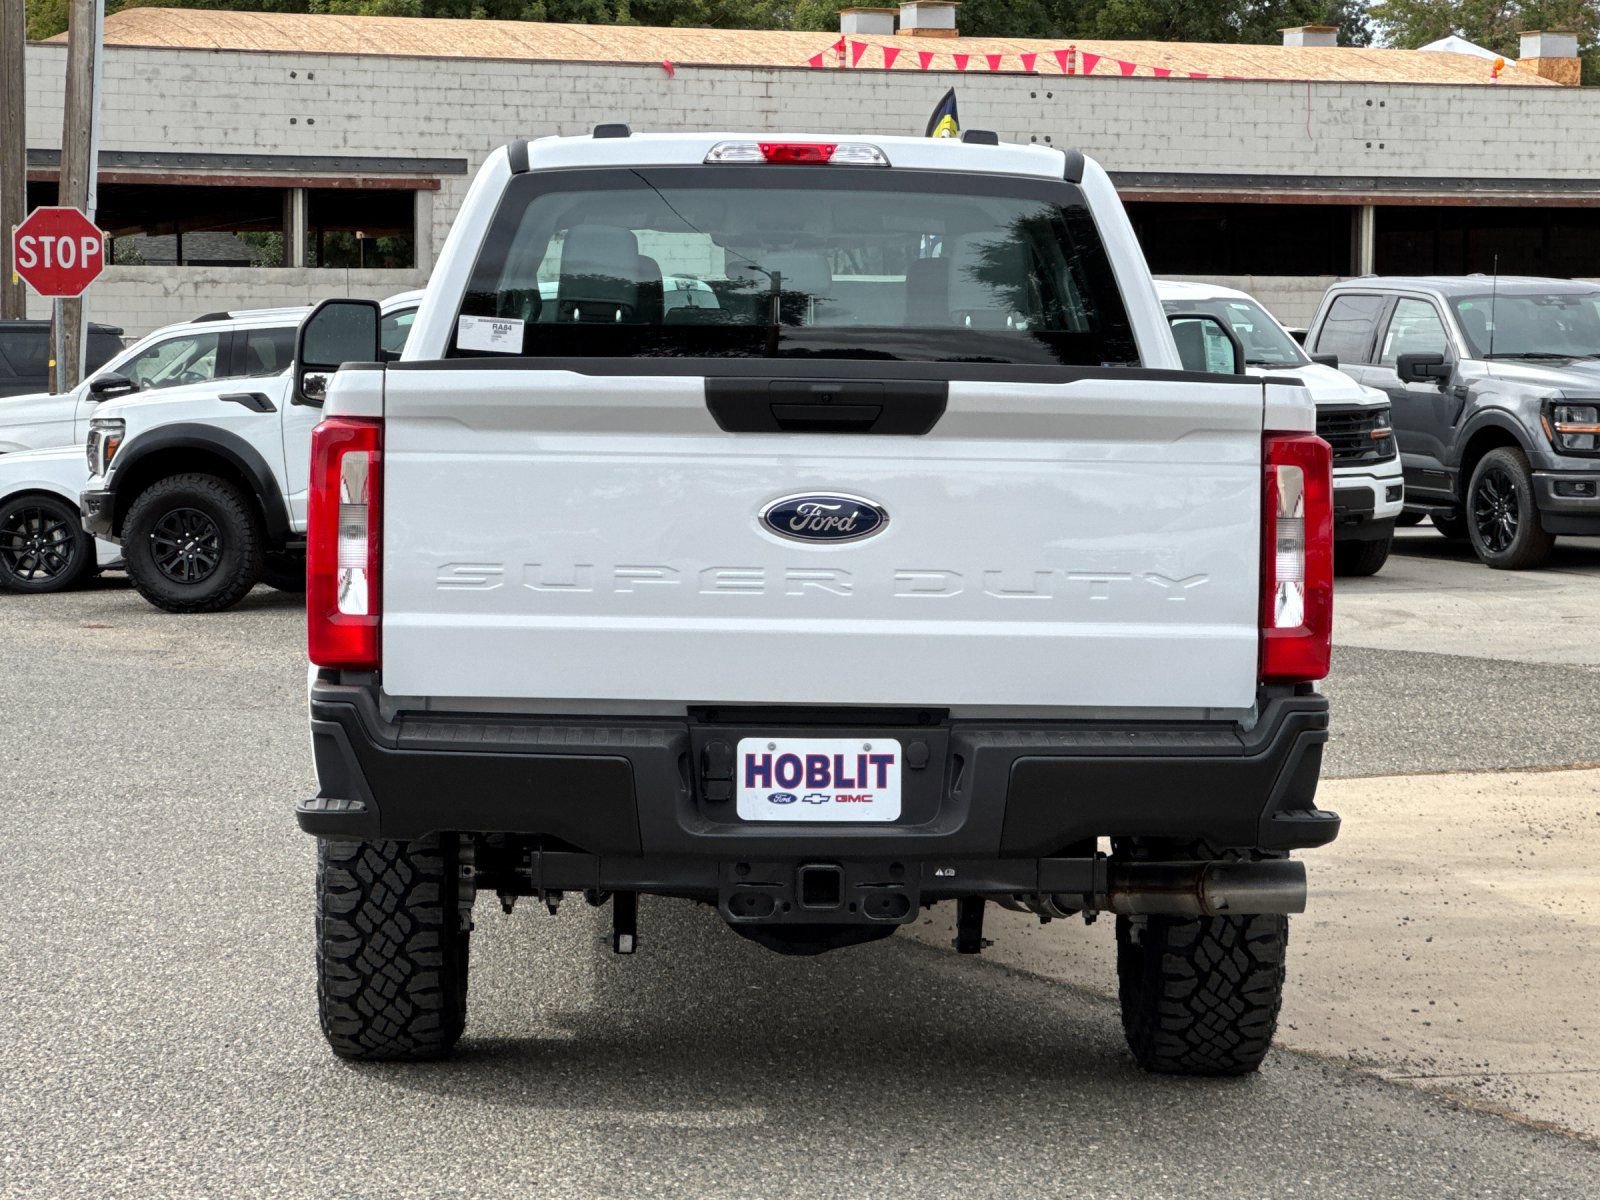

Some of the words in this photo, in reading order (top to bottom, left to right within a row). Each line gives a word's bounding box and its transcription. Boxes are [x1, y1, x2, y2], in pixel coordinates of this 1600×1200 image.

[19, 235, 99, 269] STOP
[789, 502, 859, 532] Ford
[437, 562, 853, 597] SUPER
[894, 568, 1209, 601] DUTY
[745, 753, 895, 789] HOBLIT
[773, 792, 792, 804] Ford
[835, 794, 873, 803] GMC
